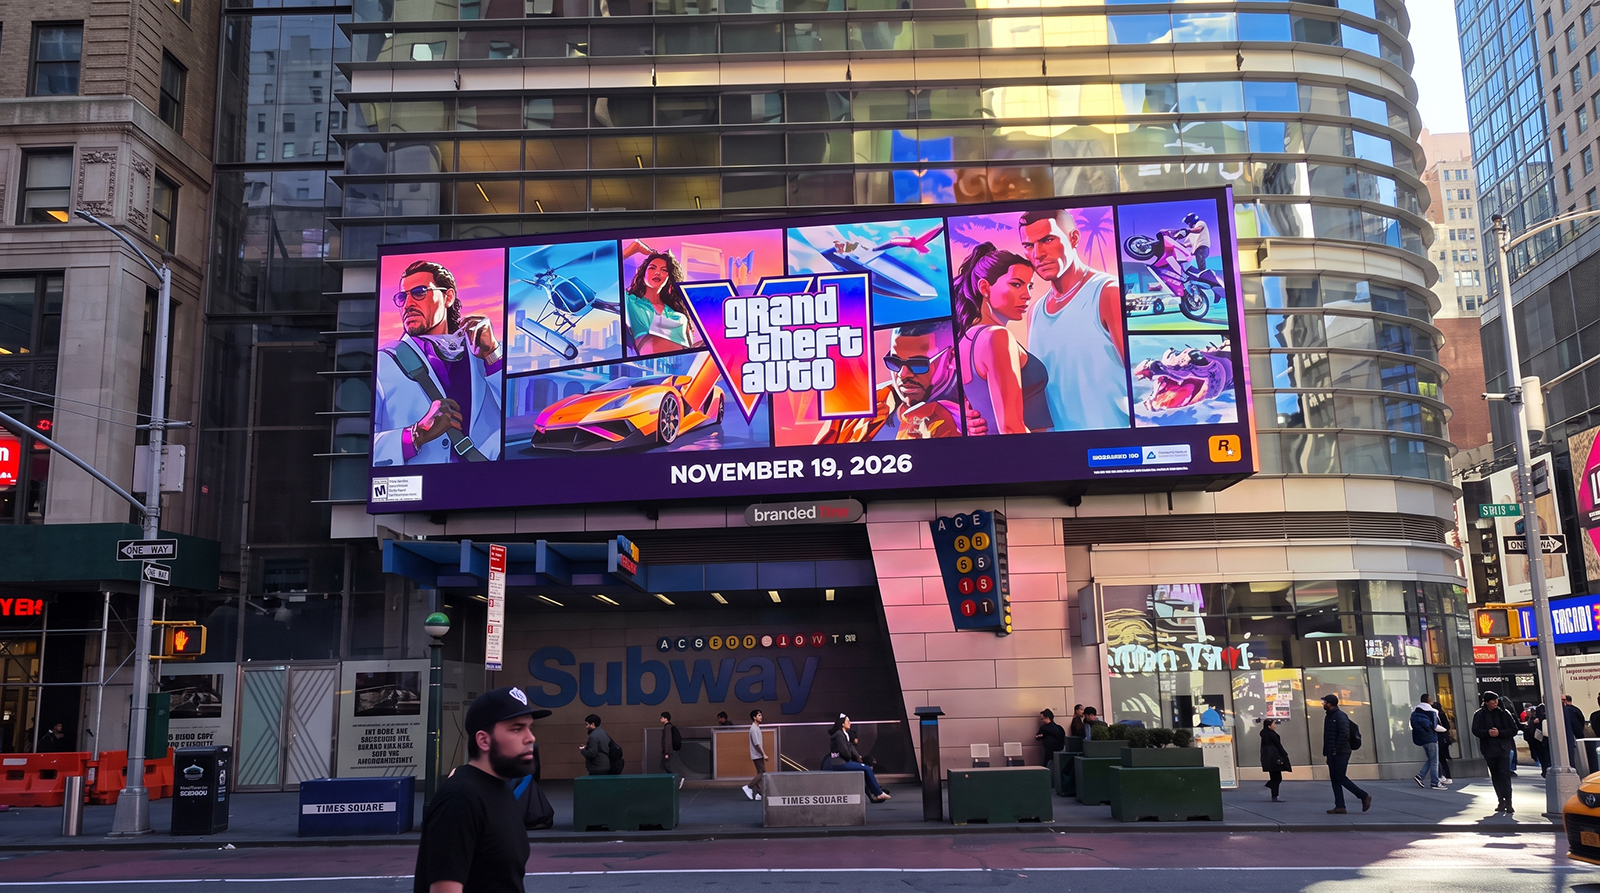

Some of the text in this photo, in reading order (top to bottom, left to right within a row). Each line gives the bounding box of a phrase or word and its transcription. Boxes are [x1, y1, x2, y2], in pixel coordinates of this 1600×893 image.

[725, 286, 838, 338] grand
[746, 326, 862, 361] theft
[742, 358, 834, 394] auto
[1218, 439, 1230, 451] R
[670, 453, 913, 484] NOVEMBER 19, 2026
[374, 485, 386, 497] M
[754, 506, 816, 522] branded
[938, 514, 980, 531] A C E
[126, 545, 169, 554] ONE WAY
[1510, 541, 1527, 549] ONE
[963, 581, 967, 591] 1
[965, 603, 970, 614] 1
[661, 640, 668, 649] A
[678, 639, 686, 648] C
[713, 638, 719, 646] E
[729, 638, 736, 647] D
[746, 637, 753, 646] D
[832, 634, 839, 644] T
[526, 646, 820, 714] Subway
[812, 796, 848, 804] SQUARE
[316, 804, 384, 813] TIMES SQUARE
